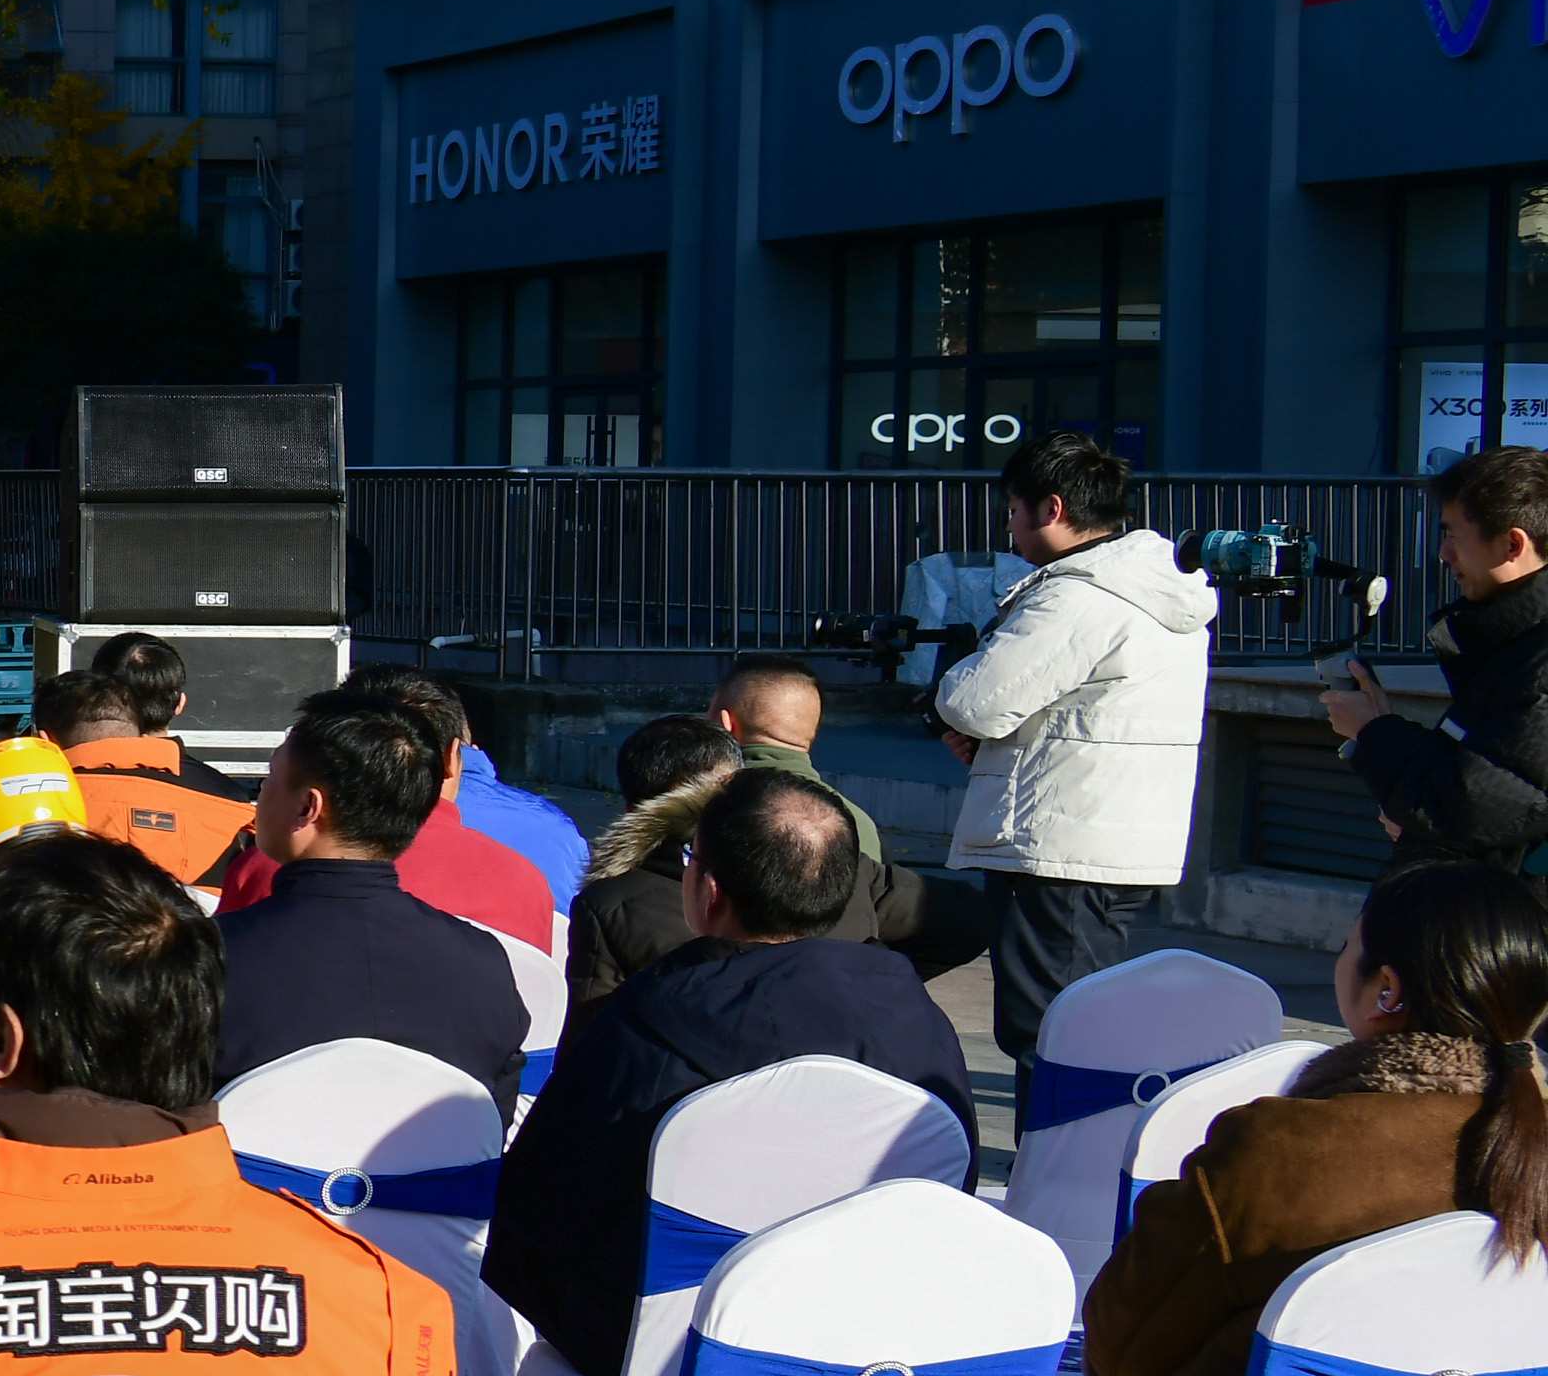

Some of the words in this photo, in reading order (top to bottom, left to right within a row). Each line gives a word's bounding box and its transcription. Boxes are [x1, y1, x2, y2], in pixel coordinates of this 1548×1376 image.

[838, 13, 1078, 142] oppo
[408, 111, 566, 203] HONOR
[578, 93, 661, 181] 荣耀
[196, 469, 226, 481] QSC
[197, 593, 227, 605] QSC
[84, 1173, 154, 1185] Alibaba
